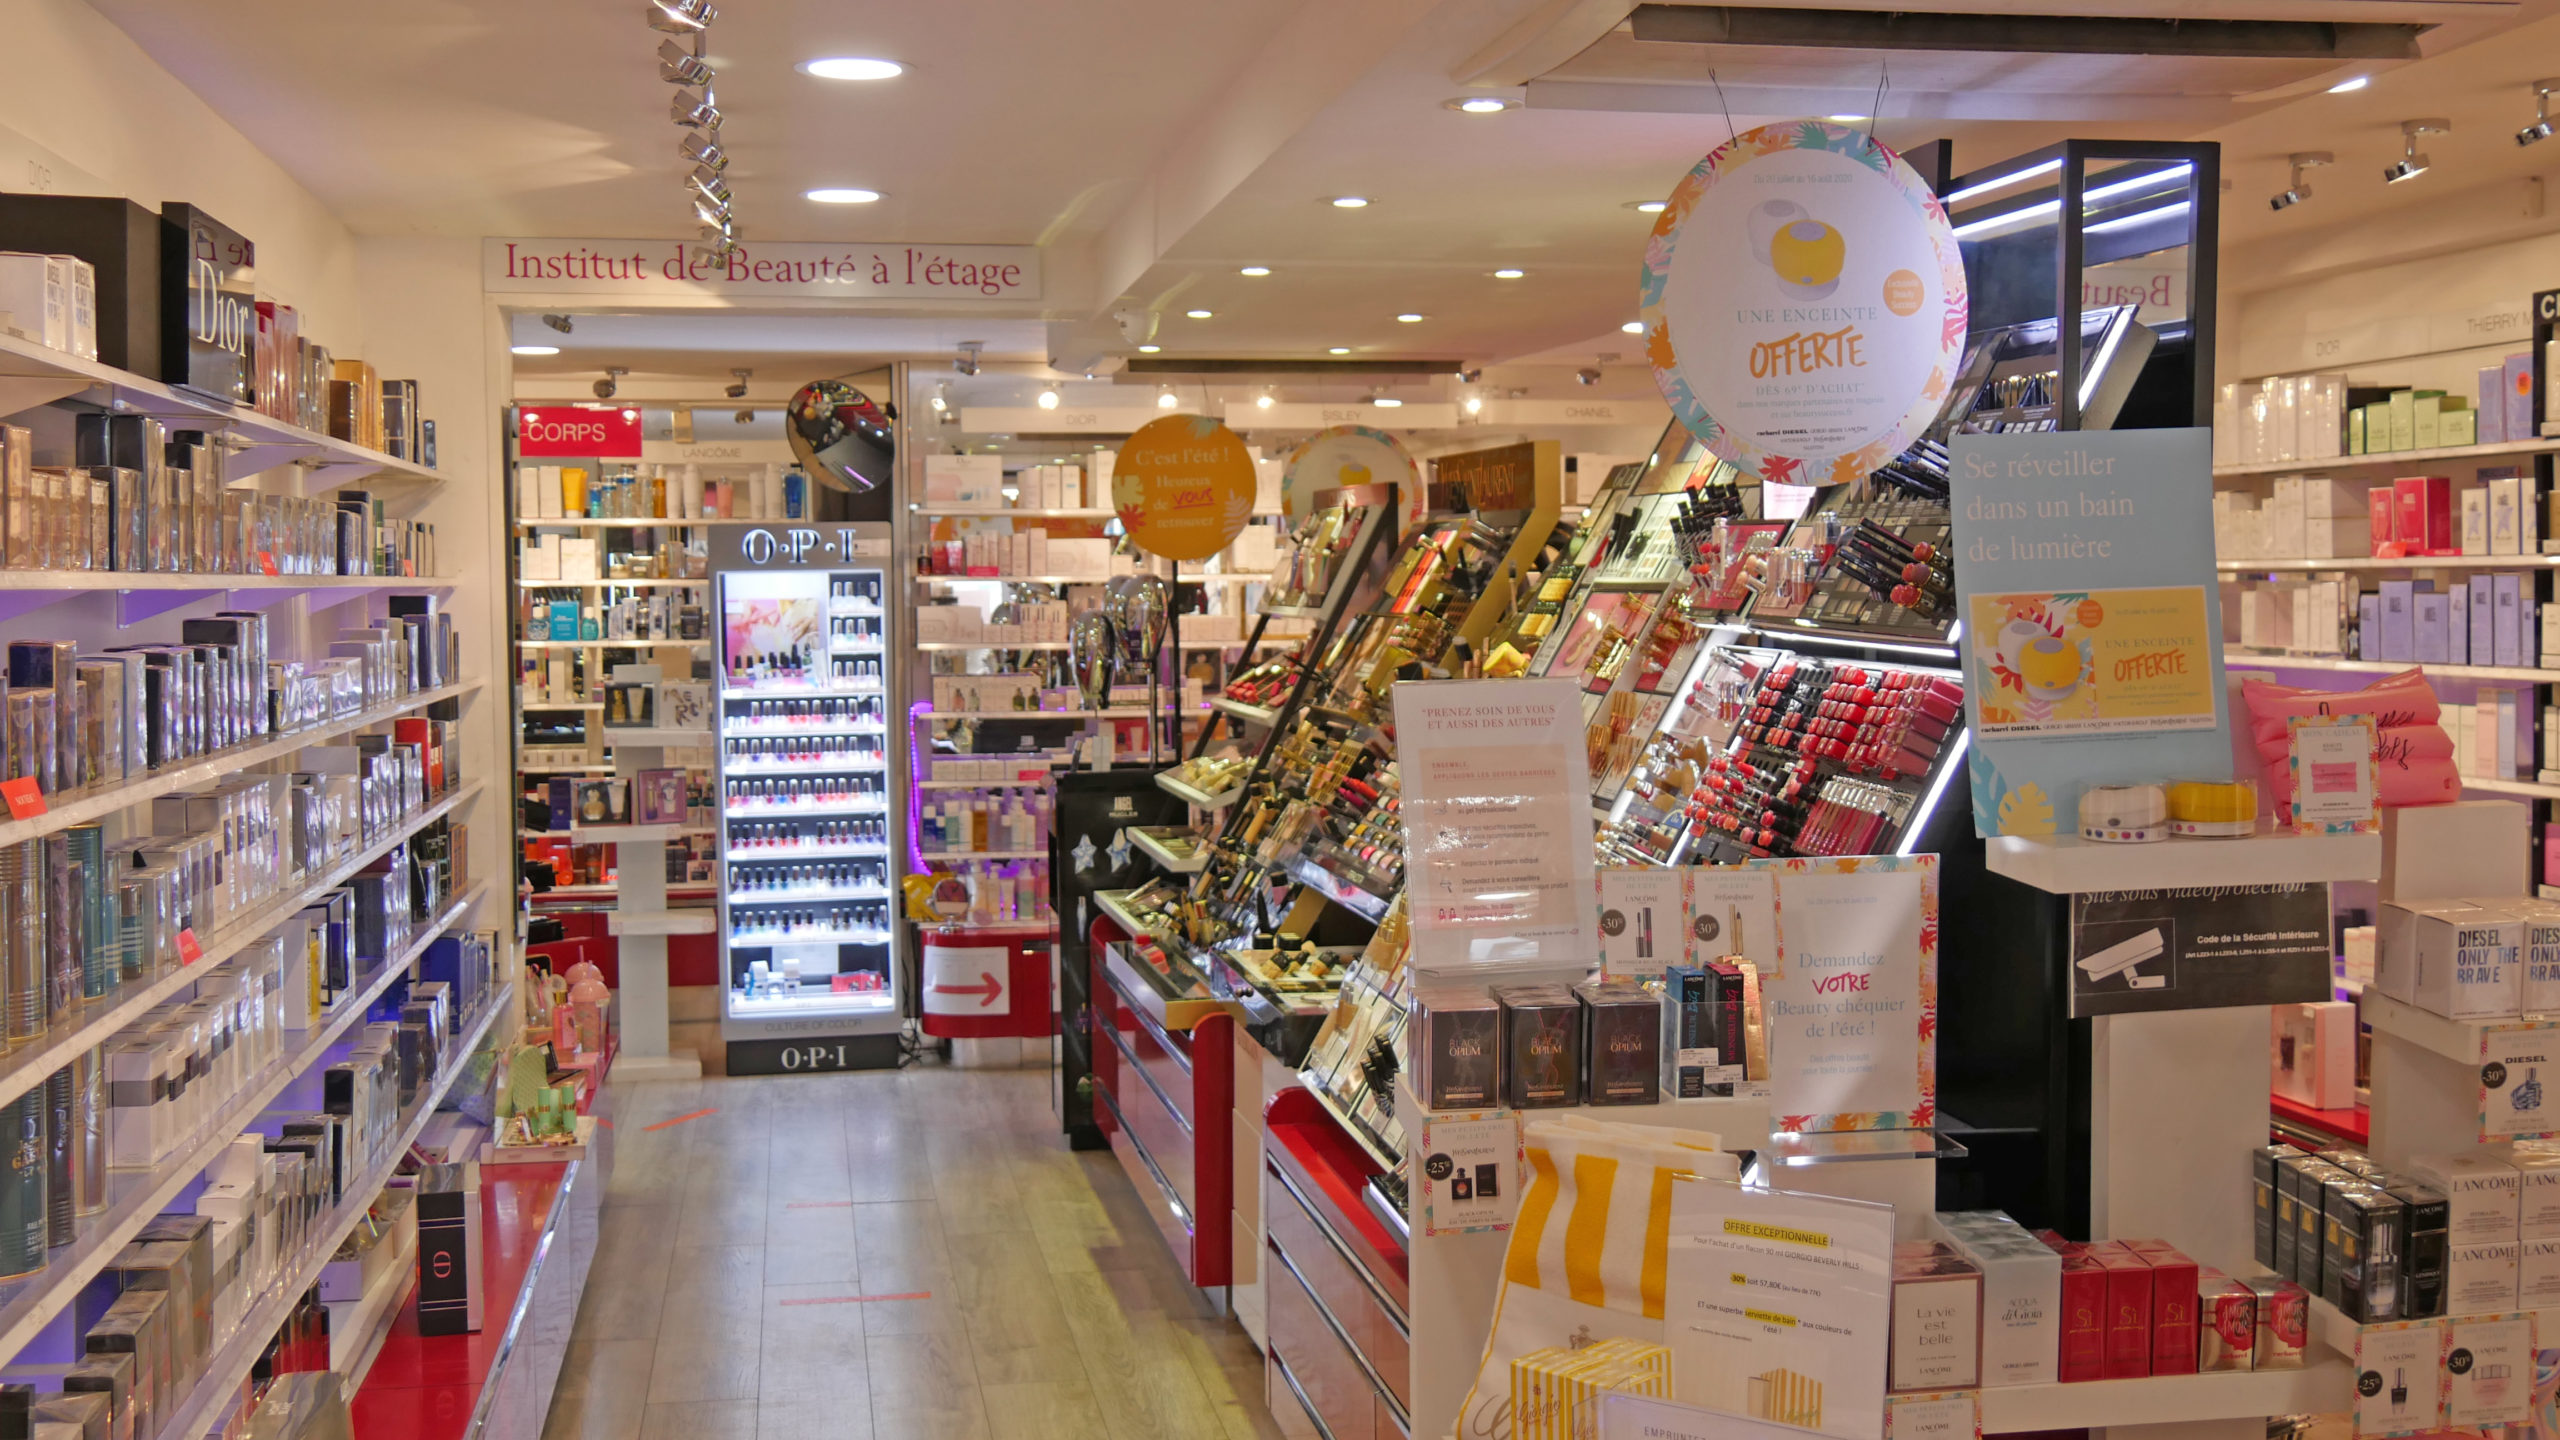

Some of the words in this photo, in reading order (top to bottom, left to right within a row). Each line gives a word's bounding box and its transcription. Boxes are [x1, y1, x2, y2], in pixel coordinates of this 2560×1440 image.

[505, 243, 647, 280] Institut
[663, 245, 709, 281] de
[725, 250, 856, 284] Beauté
[872, 255, 891, 285] à
[904, 247, 1022, 295] l'étage
[197, 258, 249, 358] Dior
[1737, 308, 1775, 324] UNE
[1782, 306, 1878, 323] ENCEINTE
[2467, 311, 2518, 334] THIERRY
[1750, 325, 1868, 379] OFFERTE
[2316, 339, 2340, 357] DIOR
[1756, 384, 1780, 396] DÈS
[1066, 414, 1096, 425] DIOR
[1322, 410, 1361, 421] SISLEY
[1566, 407, 1614, 418] CHANEL
[528, 422, 606, 442] CORPS
[682, 446, 742, 459] LANCÔME
[1136, 449, 1178, 466] C'est
[1183, 447, 1219, 464] l'été
[1965, 453, 2000, 479] Se
[2008, 450, 2116, 478] réveiller
[1156, 474, 1212, 488] Heureux
[1153, 498, 1169, 511] de
[1967, 495, 2028, 521] dans
[2037, 498, 2070, 518] un
[2080, 489, 2135, 517] bain
[1969, 537, 2000, 562] de
[2011, 534, 2112, 560] lumière
[2105, 639, 2131, 649] UNE
[2134, 636, 2196, 648] ENCEINTE
[2114, 648, 2189, 682] OFFERTE
[1475, 705, 1503, 716] SOIN
[1507, 705, 1522, 715] DE
[1525, 704, 1555, 714] VOUS
[1428, 720, 1443, 730] ET
[1447, 719, 1478, 729] AUSSI
[1482, 718, 1504, 728] DES
[1981, 725, 2009, 735] cacharel
[2011, 724, 2042, 732] DIESEL
[2119, 888, 2159, 902] sous
[2197, 935, 2218, 944] Code
[2220, 934, 2231, 943] de
[2233, 933, 2242, 942] la
[2243, 931, 2277, 942] Sécurité
[2279, 930, 2319, 941] Intérieure
[2459, 929, 2502, 948] DIESEL
[1800, 951, 1885, 969] Demandez
[2458, 950, 2489, 966] ONLY
[2498, 946, 2520, 964] THE
[2457, 966, 2501, 984] BRAVE
[1812, 972, 1871, 995] VOTRE
[1777, 1000, 1831, 1018] Beauty
[1836, 997, 1906, 1017] chéquier
[812, 1019, 825, 1029] OF
[1806, 1023, 1825, 1038] de
[1830, 1020, 1866, 1037] l'été
[1871, 1020, 1875, 1035] !
[1450, 1038, 1481, 1048] BLACK
[1610, 1042, 1642, 1053] OPIUM
[1449, 1046, 1481, 1057] OPIUM
[1531, 1045, 1562, 1056] OPIUM
[2505, 1055, 2547, 1064] DIESEL
[2453, 1176, 2518, 1193] LANCÔME
[1723, 1221, 1751, 1233] OFFRE
[1753, 1226, 1828, 1246] EXCEPTIONNELLE
[1830, 1237, 1834, 1247] !
[1694, 1236, 1707, 1245] Pour
[1709, 1238, 1729, 1249] l'achat
[1731, 1241, 1745, 1250] d'un
[1785, 1251, 1813, 1263] GIORGIO
[1813, 1256, 1841, 1268] BEVERLY
[2453, 1247, 2517, 1263] LANCÔME
[1730, 1274, 1746, 1284] -30%
[1747, 1278, 1758, 1286] soit
[1917, 1308, 1932, 1319] La
[1936, 1306, 1956, 1318] vie
[2224, 1304, 2249, 1318] AMOR
[1706, 1303, 1717, 1311] une
[1745, 1309, 1772, 1321] serviette
[1773, 1314, 1781, 1323] de
[1782, 1316, 1796, 1325] bain
[1802, 1321, 1814, 1329] aux
[1815, 1322, 1842, 1335] couleurs
[1924, 1320, 1948, 1331] est
[2223, 1318, 2248, 1334] AMOR
[1763, 1325, 1778, 1335] l'été
[1919, 1333, 1954, 1346] belle
[1919, 1366, 1952, 1375] LANCÔME
[1644, 1425, 1706, 1440] EMPRUNT
[1915, 1422, 1949, 1432] LANCÔME
